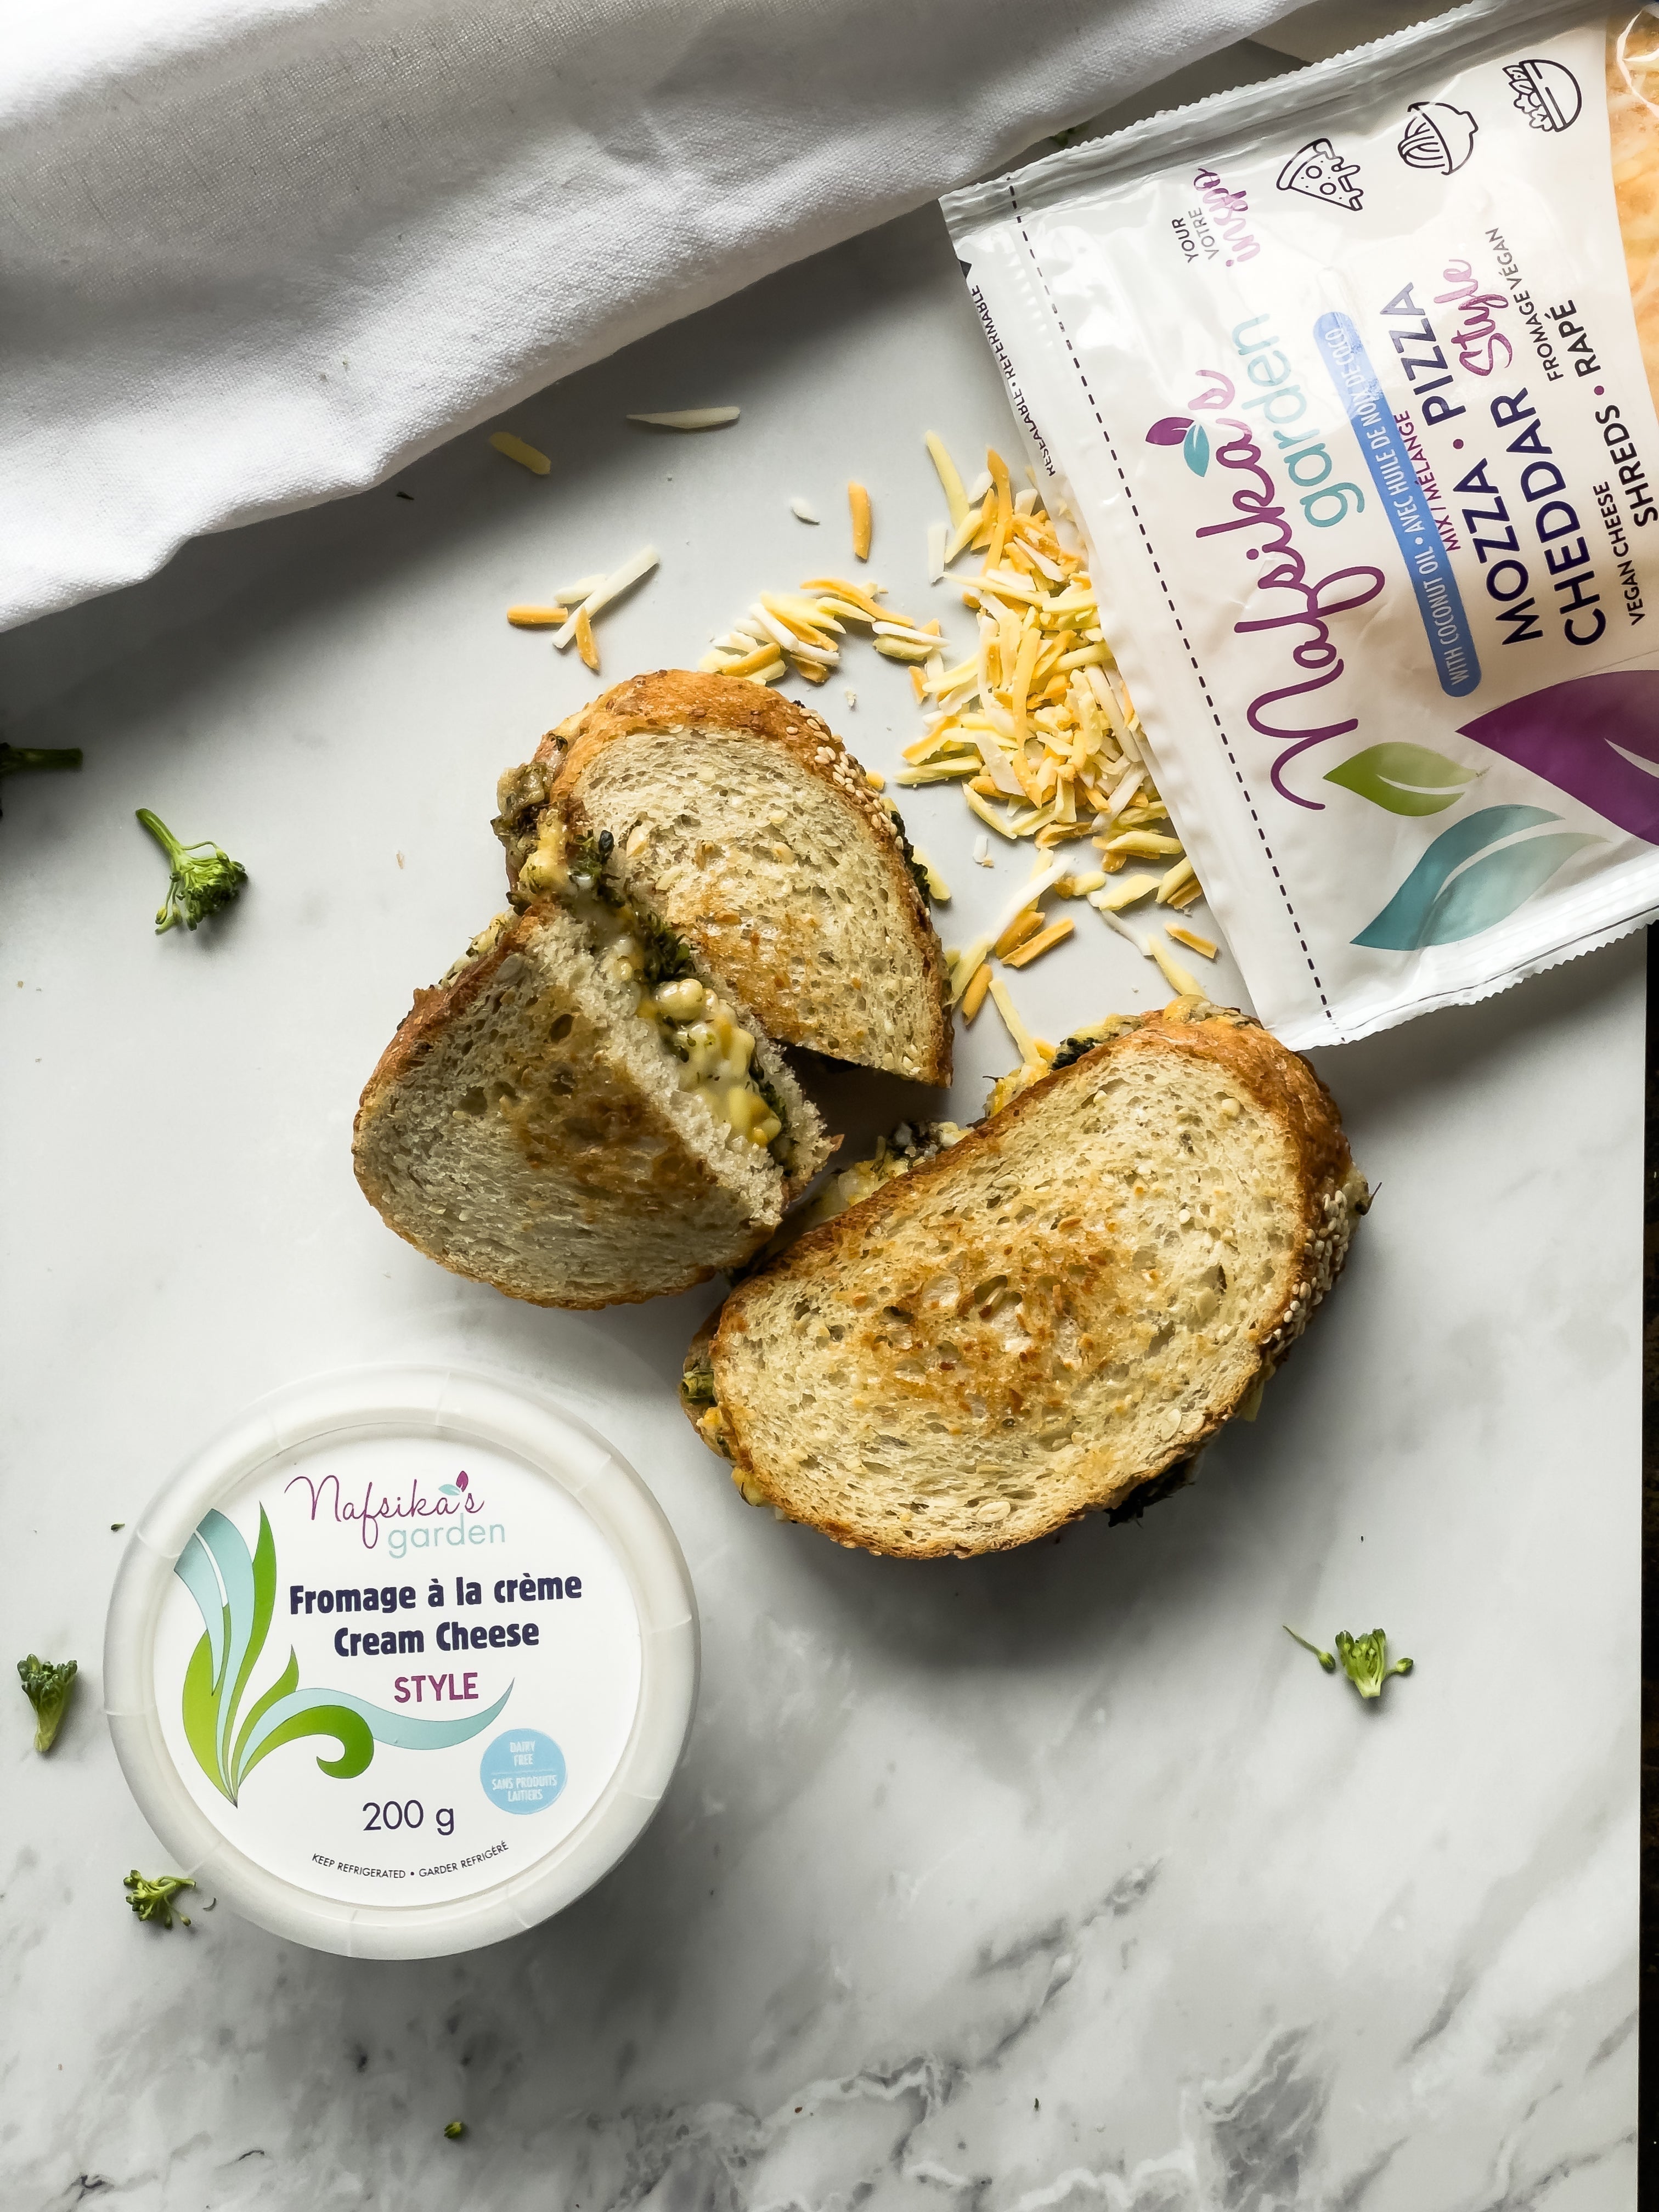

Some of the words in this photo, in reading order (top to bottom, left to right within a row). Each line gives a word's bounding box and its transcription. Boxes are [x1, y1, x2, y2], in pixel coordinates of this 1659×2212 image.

[1171, 218, 1199, 263] YOUR
[1188, 207, 1219, 260] VOTRE
[1485, 227, 1522, 290] VÉGAN
[972, 285, 1015, 380] REFERMABLE
[1433, 259, 1513, 376] Style
[1513, 290, 1564, 381] FROMAGE
[1543, 300, 1601, 377] RAPÉ
[1325, 328, 1354, 365] COCO
[1380, 282, 1466, 426] PIZZA
[1341, 364, 1363, 388] DE
[1232, 313, 1363, 527] garden
[1352, 391, 1381, 426] NOIX
[1013, 388, 1056, 476] RESEALABLE
[1367, 426, 1390, 451] DE
[1375, 448, 1409, 495] HUILE
[1393, 410, 1441, 501] MÉLANGE
[1595, 404, 1658, 527] SHREDS
[1393, 495, 1425, 533] AVEC
[1434, 515, 1461, 551] MIX
[1490, 387, 1606, 646] CHEDDAR
[1593, 481, 1630, 557] CHEESE
[1414, 546, 1439, 574] OIL
[1453, 458, 1543, 645] MOZZA
[1423, 577, 1460, 645] COCONUT
[1616, 560, 1645, 626] VEGAN
[1444, 646, 1470, 685] WITH
[387, 1513, 505, 1559] garden
[290, 1585, 416, 1615] Fromage
[428, 1578, 444, 1607] à
[456, 1576, 482, 1606] la
[494, 1572, 582, 1602] crème
[334, 1627, 424, 1657] Cream
[436, 1620, 539, 1651] Cheese
[394, 1672, 478, 1703] STYLE
[510, 1741, 535, 1753] DAIRY
[514, 1754, 533, 1766] FREE
[492, 1778, 514, 1790] SANS
[516, 1775, 557, 1788] PRODUITS
[507, 1789, 543, 1802] LAITIERS
[363, 1799, 424, 1831] 200
[436, 1808, 454, 1836] g
[312, 1853, 335, 1867] KEEP
[337, 1862, 405, 1878] REFRIGERATED
[419, 1863, 458, 1877] GARDER
